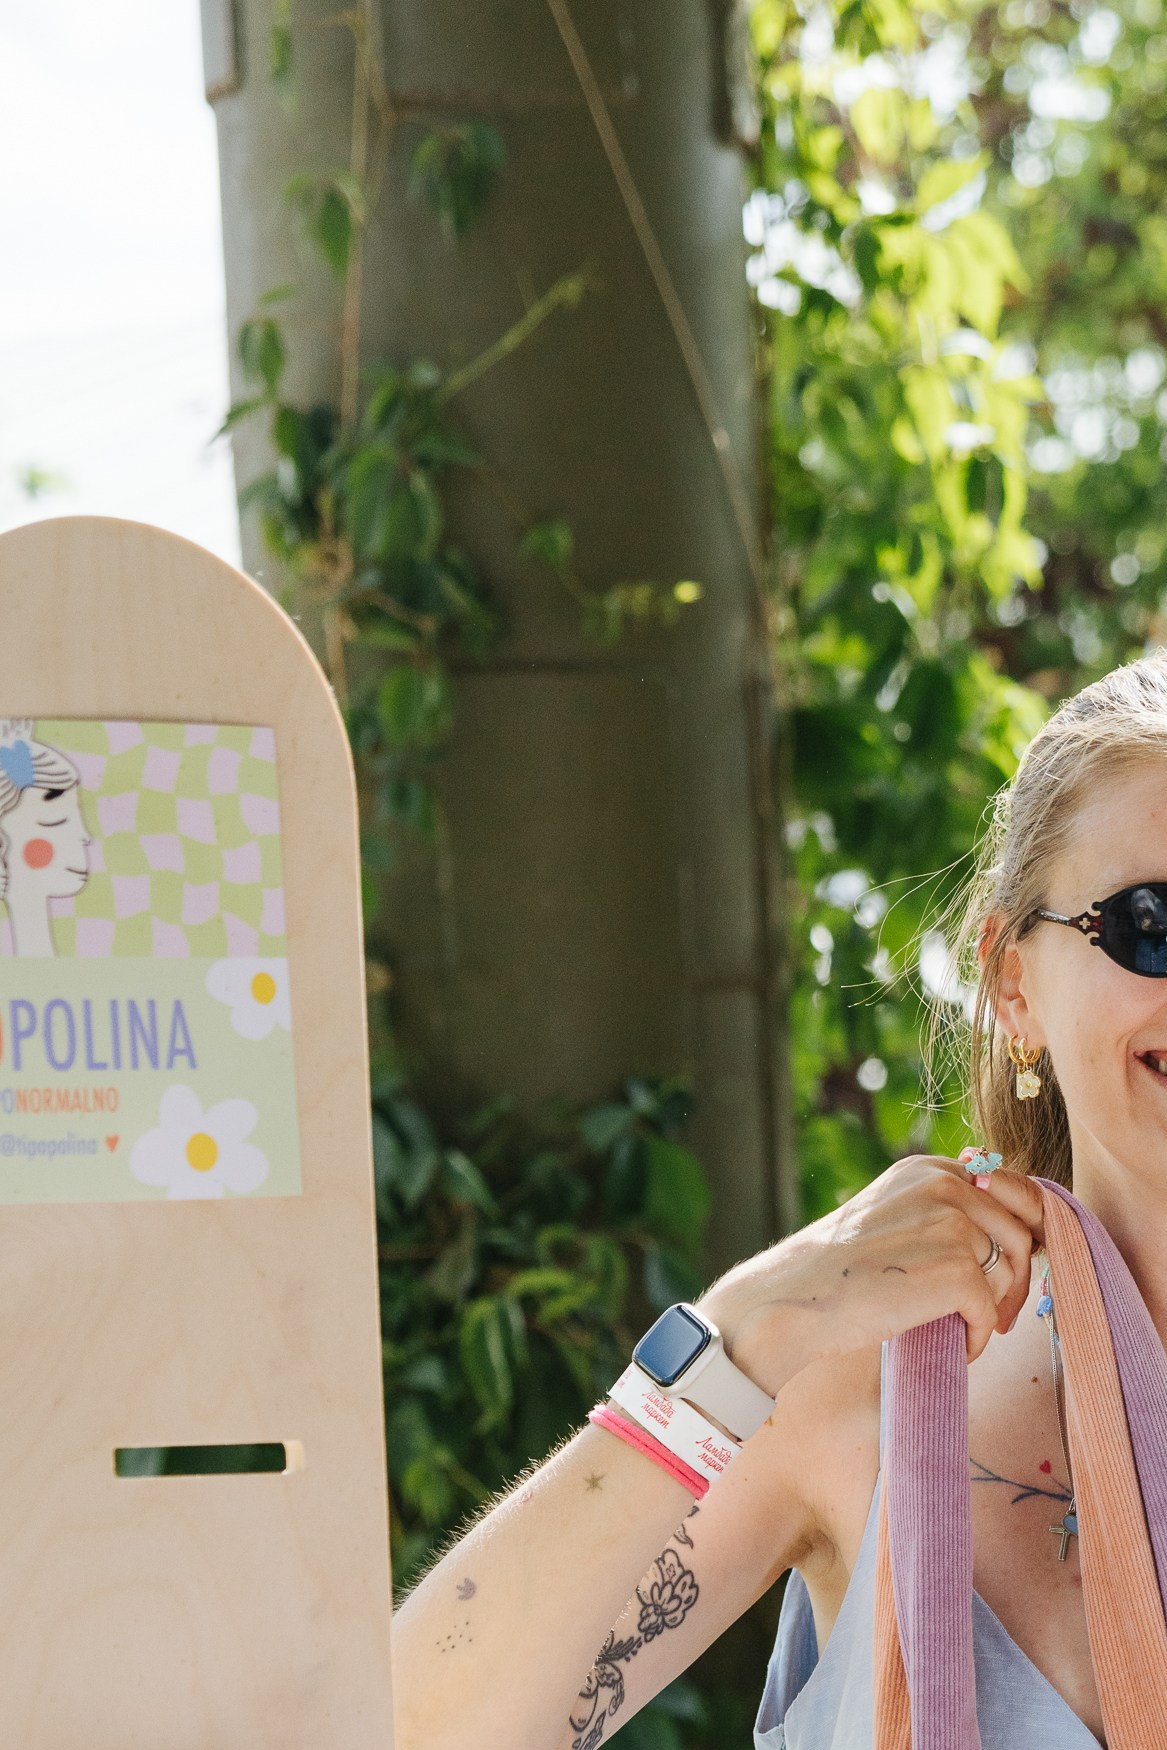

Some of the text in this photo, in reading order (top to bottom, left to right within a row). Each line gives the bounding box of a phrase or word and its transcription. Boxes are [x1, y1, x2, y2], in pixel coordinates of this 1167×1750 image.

[0, 998, 198, 1072] POLINA
[0, 1087, 119, 1114] ONORMALNO
[695, 1436, 732, 1465] Ламбад
